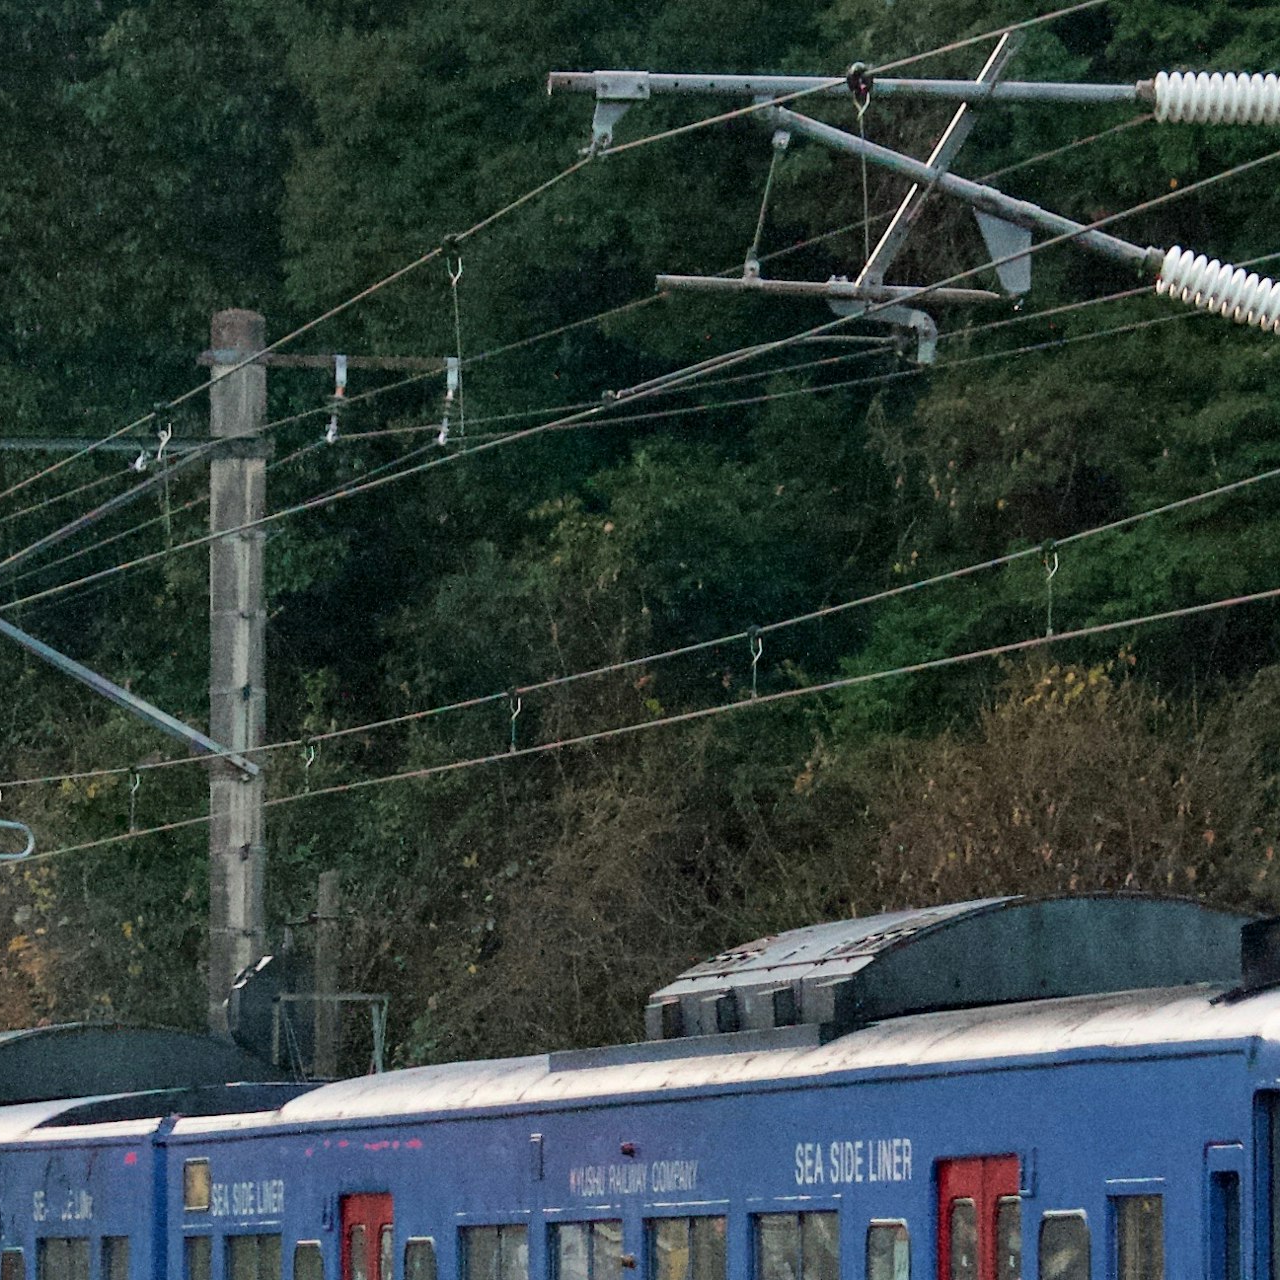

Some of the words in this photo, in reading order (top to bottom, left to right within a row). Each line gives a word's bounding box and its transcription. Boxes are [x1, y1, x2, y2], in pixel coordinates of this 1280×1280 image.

[794, 1142, 824, 1186] SEA
[830, 1141, 864, 1184] SIDE
[868, 1138, 912, 1182] LINER
